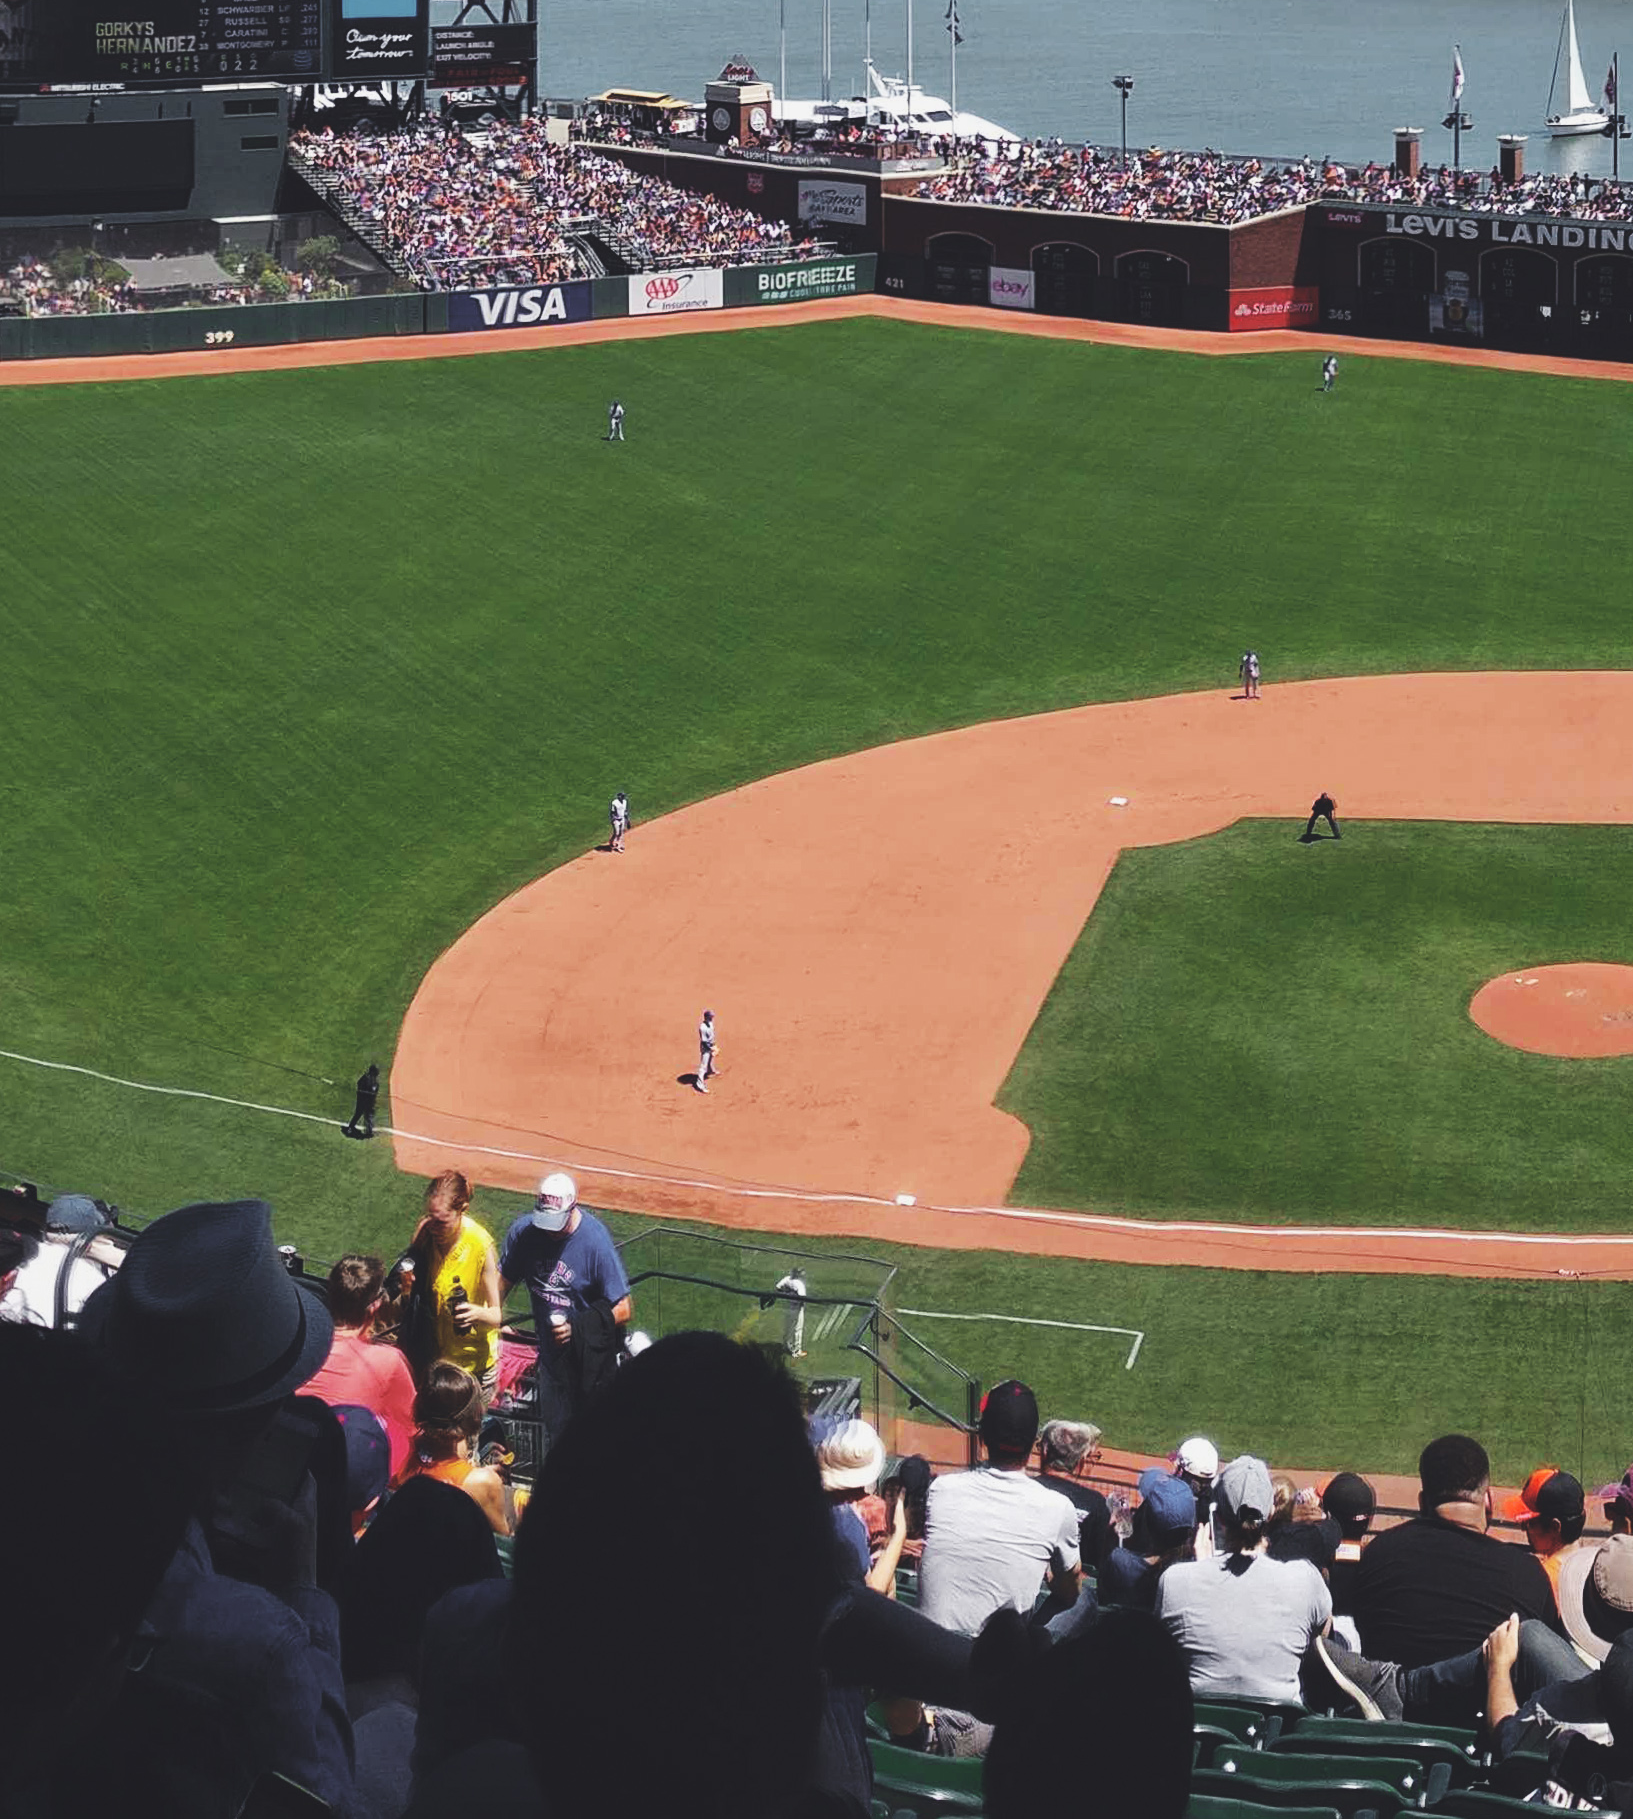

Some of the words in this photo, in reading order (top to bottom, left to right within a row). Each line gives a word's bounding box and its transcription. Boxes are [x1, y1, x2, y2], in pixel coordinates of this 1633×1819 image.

[96, 22, 155, 37] GORKYS
[96, 35, 196, 54] HERNANDEZ
[376, 33, 413, 48] your
[235, 60, 242, 71] 2
[250, 60, 257, 71] 2
[646, 277, 679, 299] AAA
[885, 278, 904, 289] 421
[993, 278, 1029, 299] ebay
[470, 287, 567, 326] VISA
[662, 298, 708, 311] Insurance
[1328, 308, 1352, 321] 365
[205, 329, 235, 344] 399
